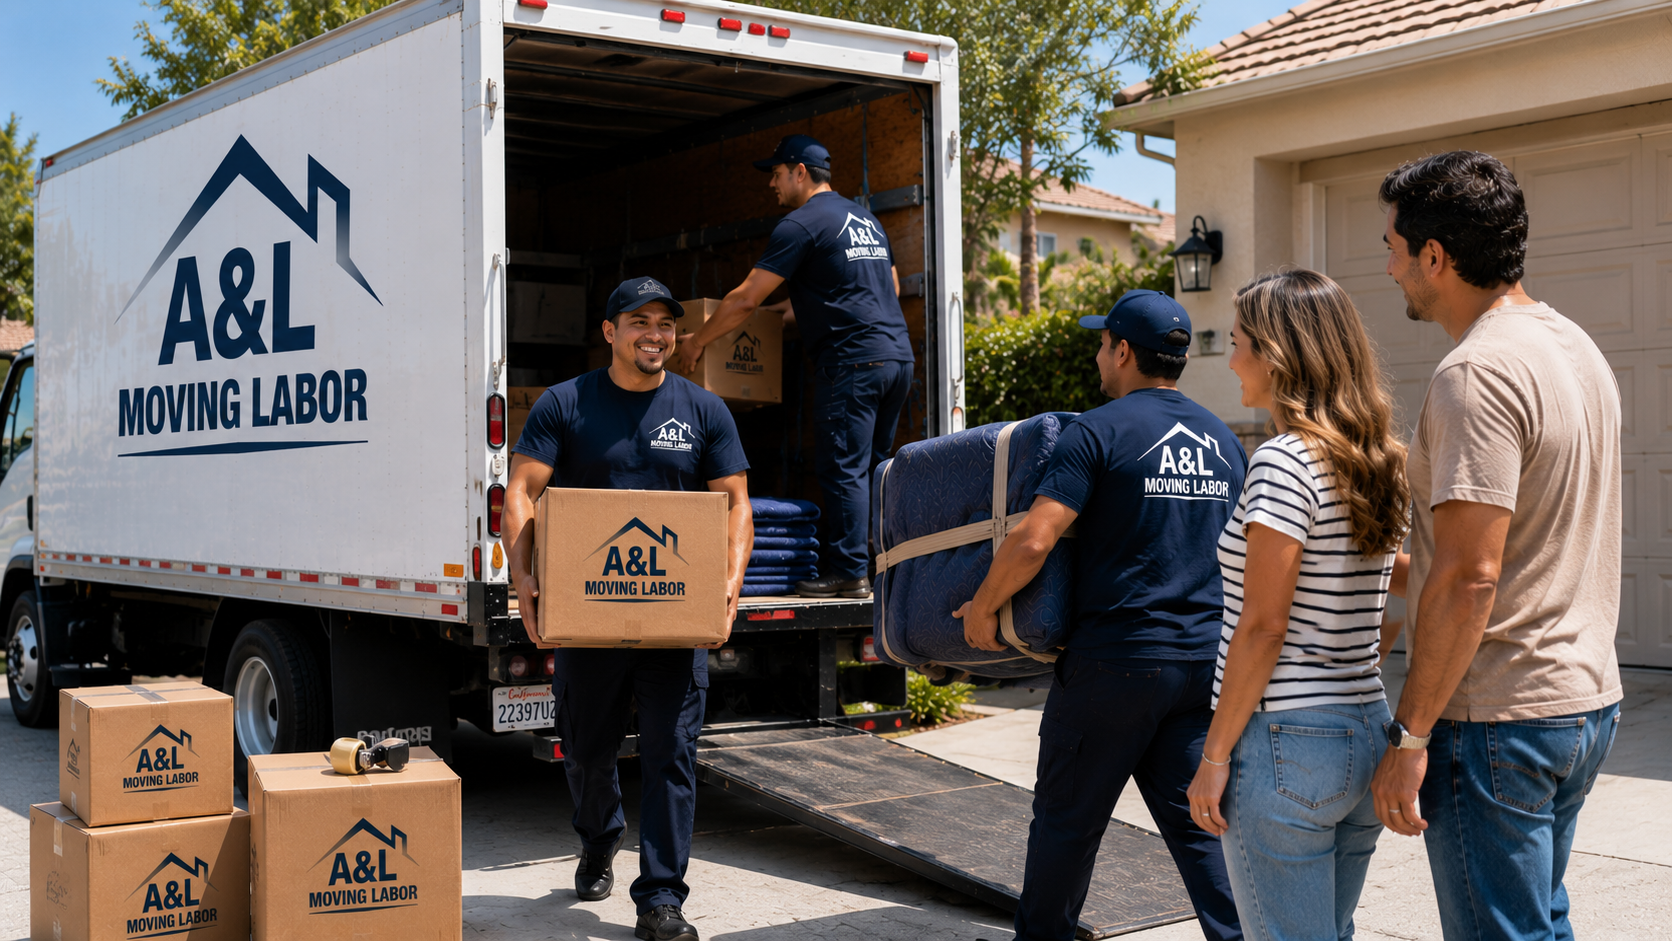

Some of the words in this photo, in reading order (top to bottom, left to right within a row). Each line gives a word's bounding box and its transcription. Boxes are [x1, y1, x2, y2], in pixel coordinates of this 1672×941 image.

[848, 226, 880, 246] A&L
[157, 240, 316, 366] A&L
[733, 344, 758, 363] A&L
[117, 378, 241, 437] MOVING
[252, 368, 369, 428] LABOR
[657, 426, 686, 442] A&L
[1158, 445, 1214, 476] A&L
[1144, 477, 1190, 494] MOVING
[1193, 479, 1229, 498] LABOR
[602, 545, 667, 577] A&L
[585, 580, 638, 596] MOVING
[641, 581, 686, 596] LABOR
[498, 700, 556, 724] 22397U2
[136, 746, 185, 773] A&L
[123, 774, 163, 789] MOVING
[166, 771, 199, 785] LABOR
[328, 849, 397, 886] A&L
[142, 878, 200, 913] A&L
[309, 888, 367, 908] MOVING
[371, 885, 418, 903] LABOR
[126, 913, 175, 934] MOVING
[178, 907, 218, 927] LABOR
